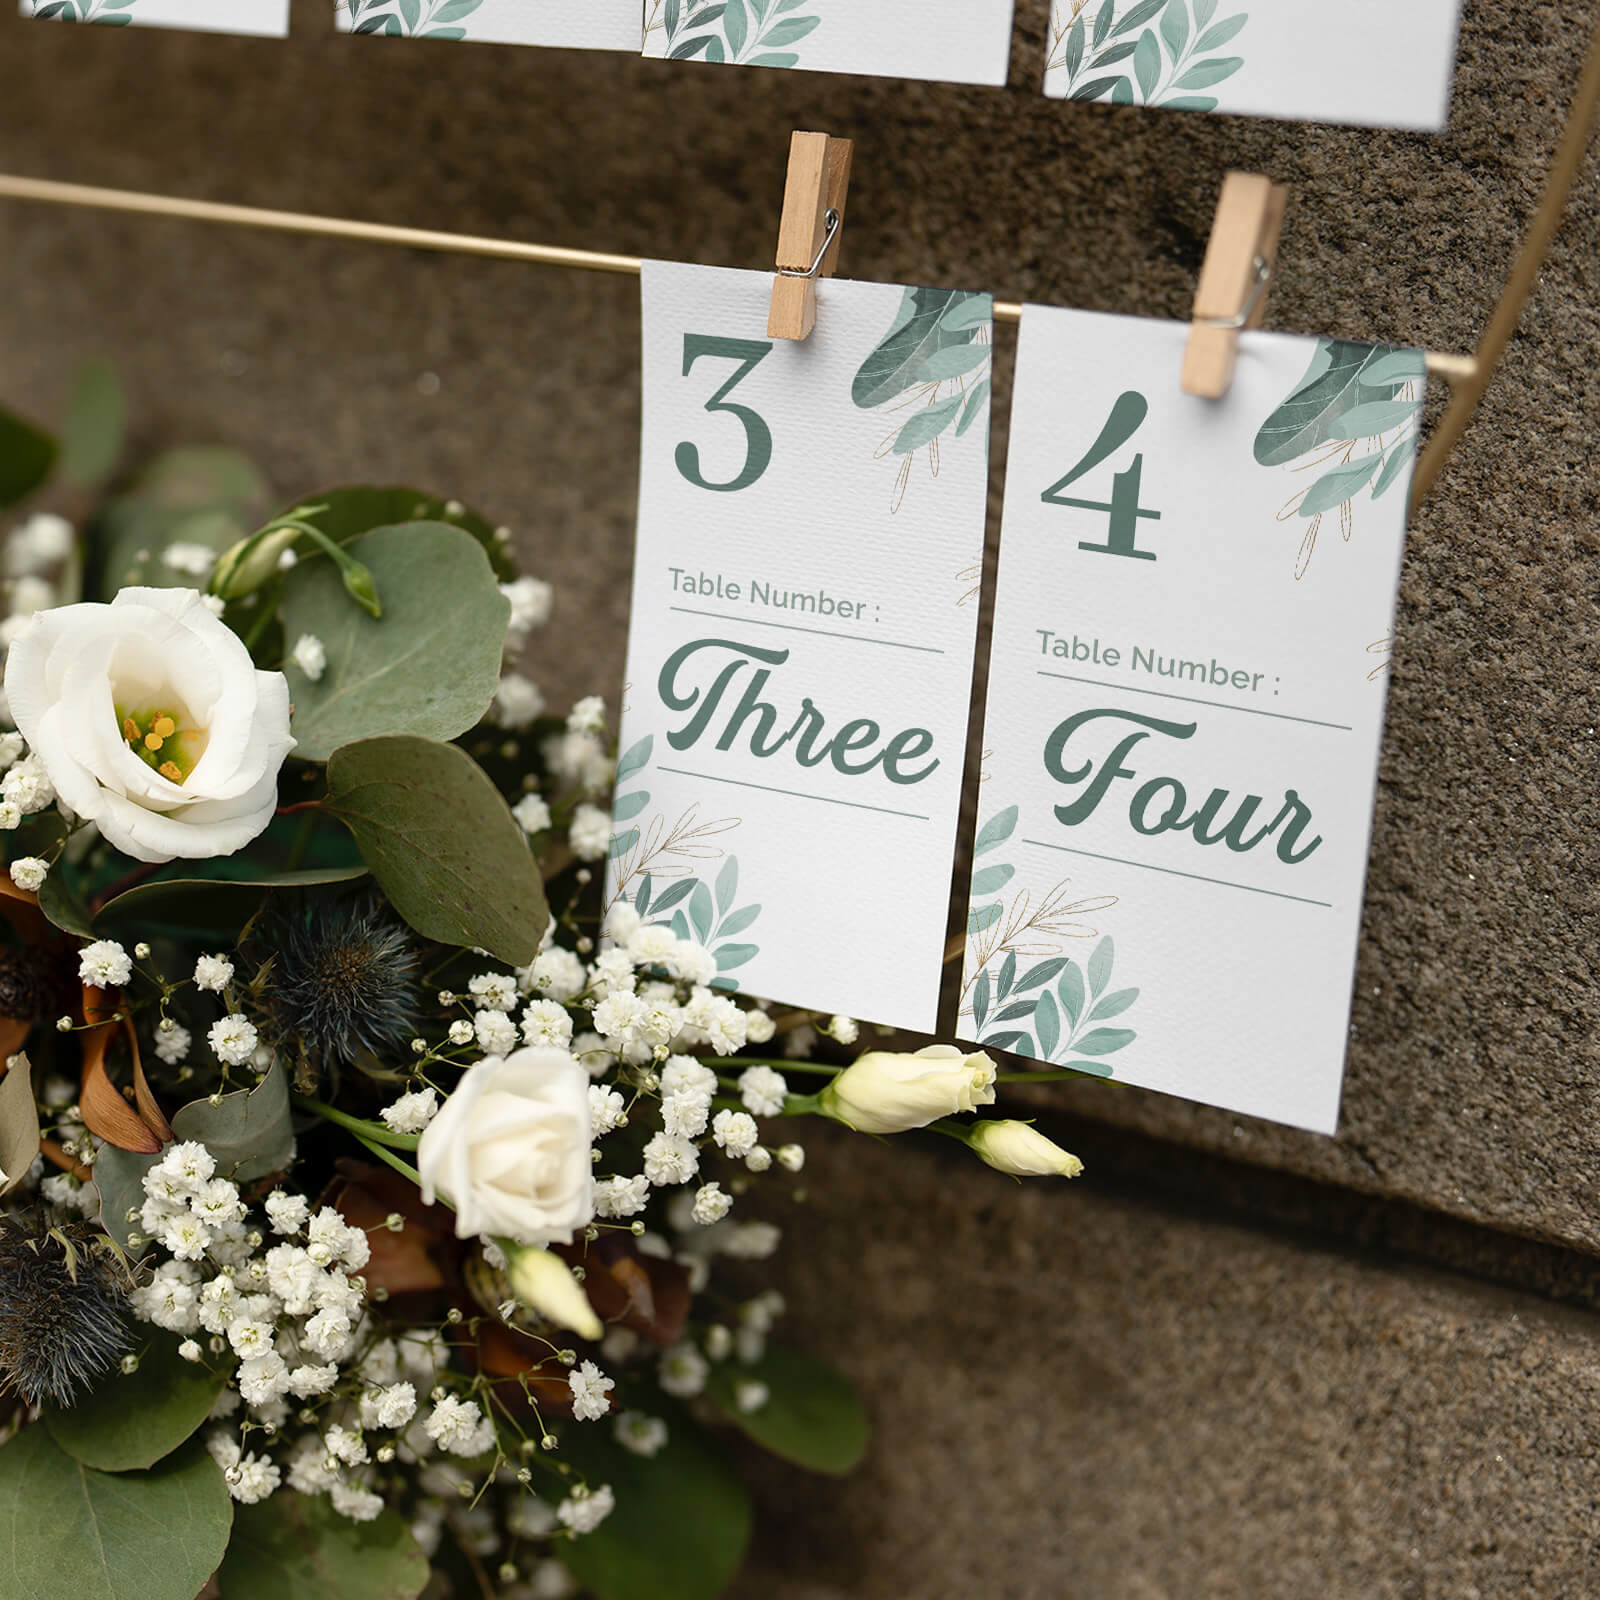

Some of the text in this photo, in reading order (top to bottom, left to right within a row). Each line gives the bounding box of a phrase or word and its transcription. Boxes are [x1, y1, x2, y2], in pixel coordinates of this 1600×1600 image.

[674, 332, 775, 492] 3
[1040, 390, 1162, 562] 4
[668, 567, 742, 602] Table
[749, 580, 868, 621] Number
[1036, 629, 1122, 668] Table
[1131, 645, 1266, 692] Number
[657, 638, 941, 786] Three
[1043, 708, 1324, 865] Four
